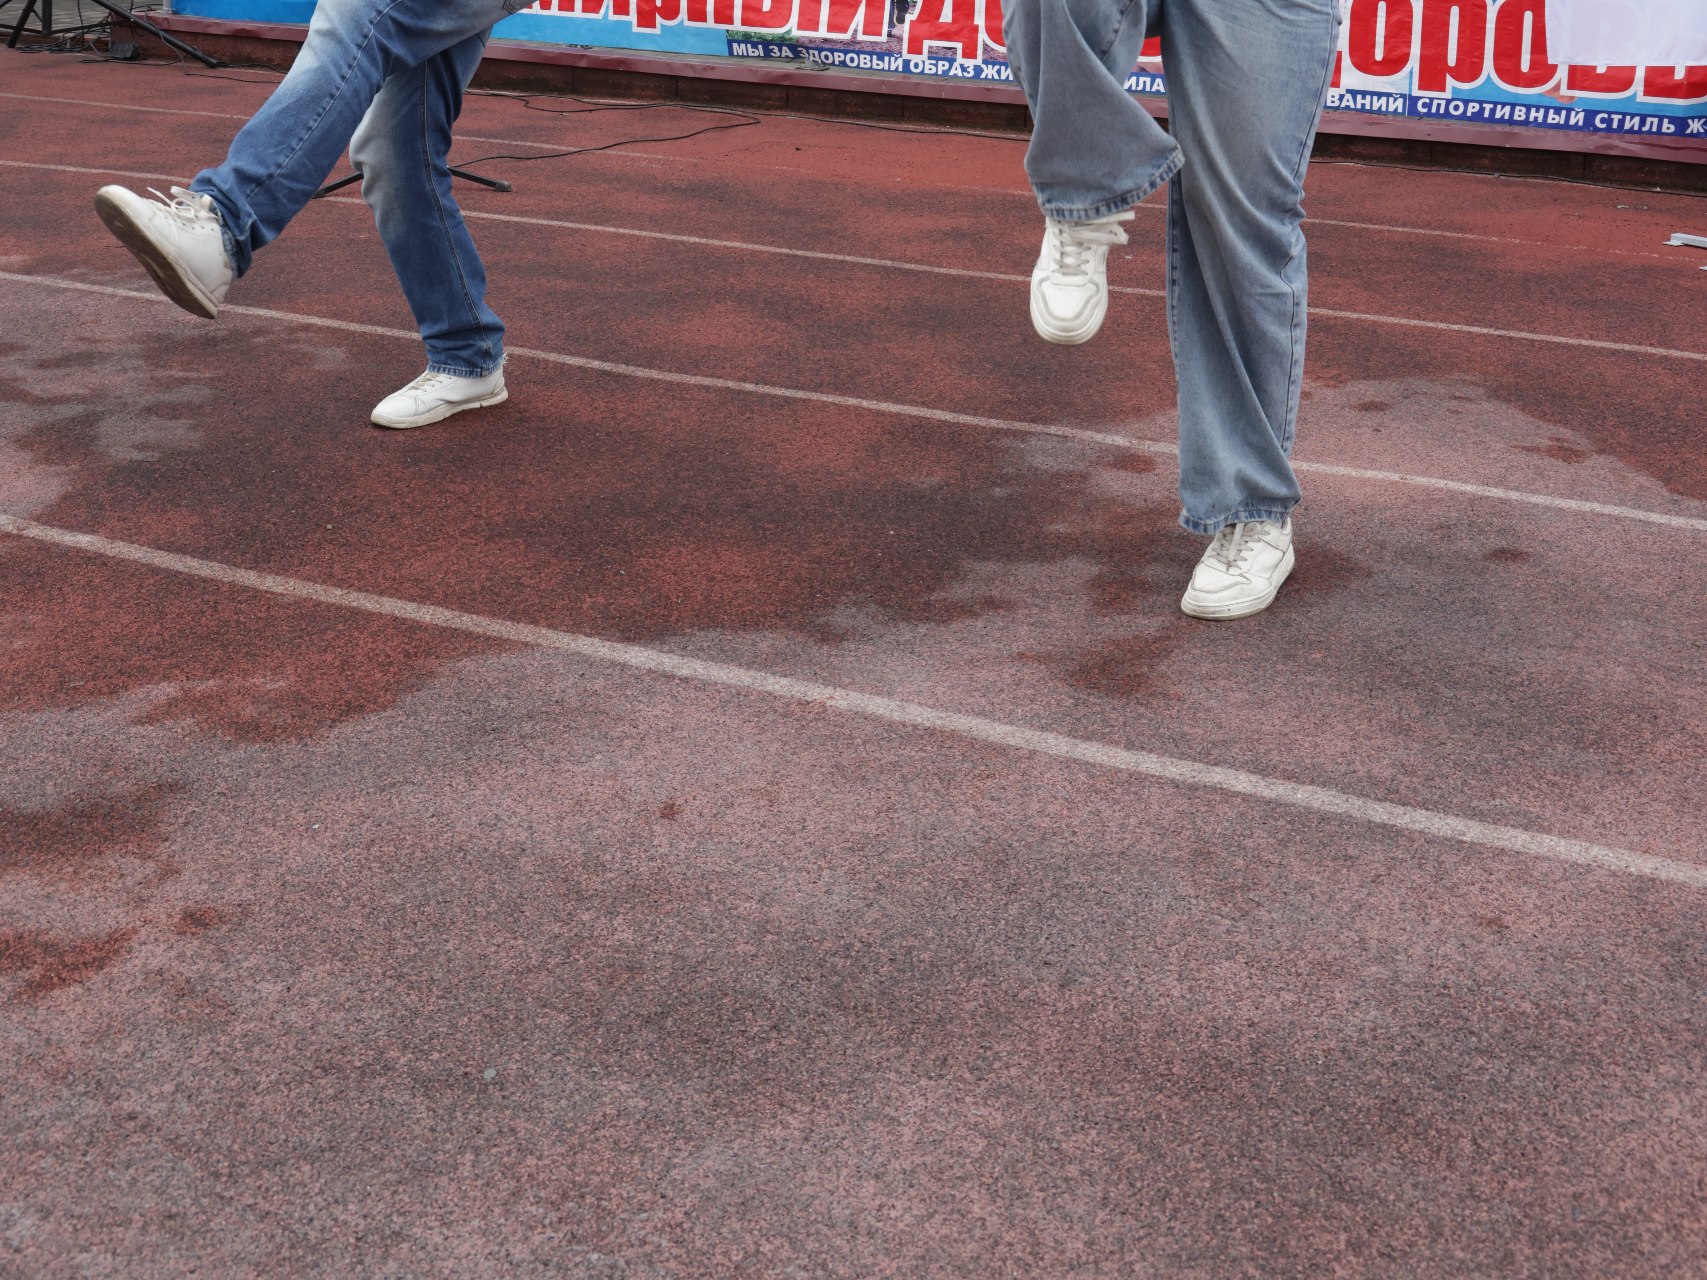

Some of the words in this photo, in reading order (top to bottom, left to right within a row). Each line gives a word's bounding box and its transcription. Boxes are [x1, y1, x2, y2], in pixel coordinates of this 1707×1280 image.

[732, 42, 764, 57] МЫ
[769, 45, 794, 59] ЗА
[798, 47, 903, 72] ЗДОРОВЫЙ
[909, 60, 974, 78] ОБРАЗ
[1325, 92, 1403, 113] ВАНИЙ
[1416, 96, 1585, 127] СПОРТИВНЫЙ
[1594, 113, 1676, 134] СТИЛЬ
